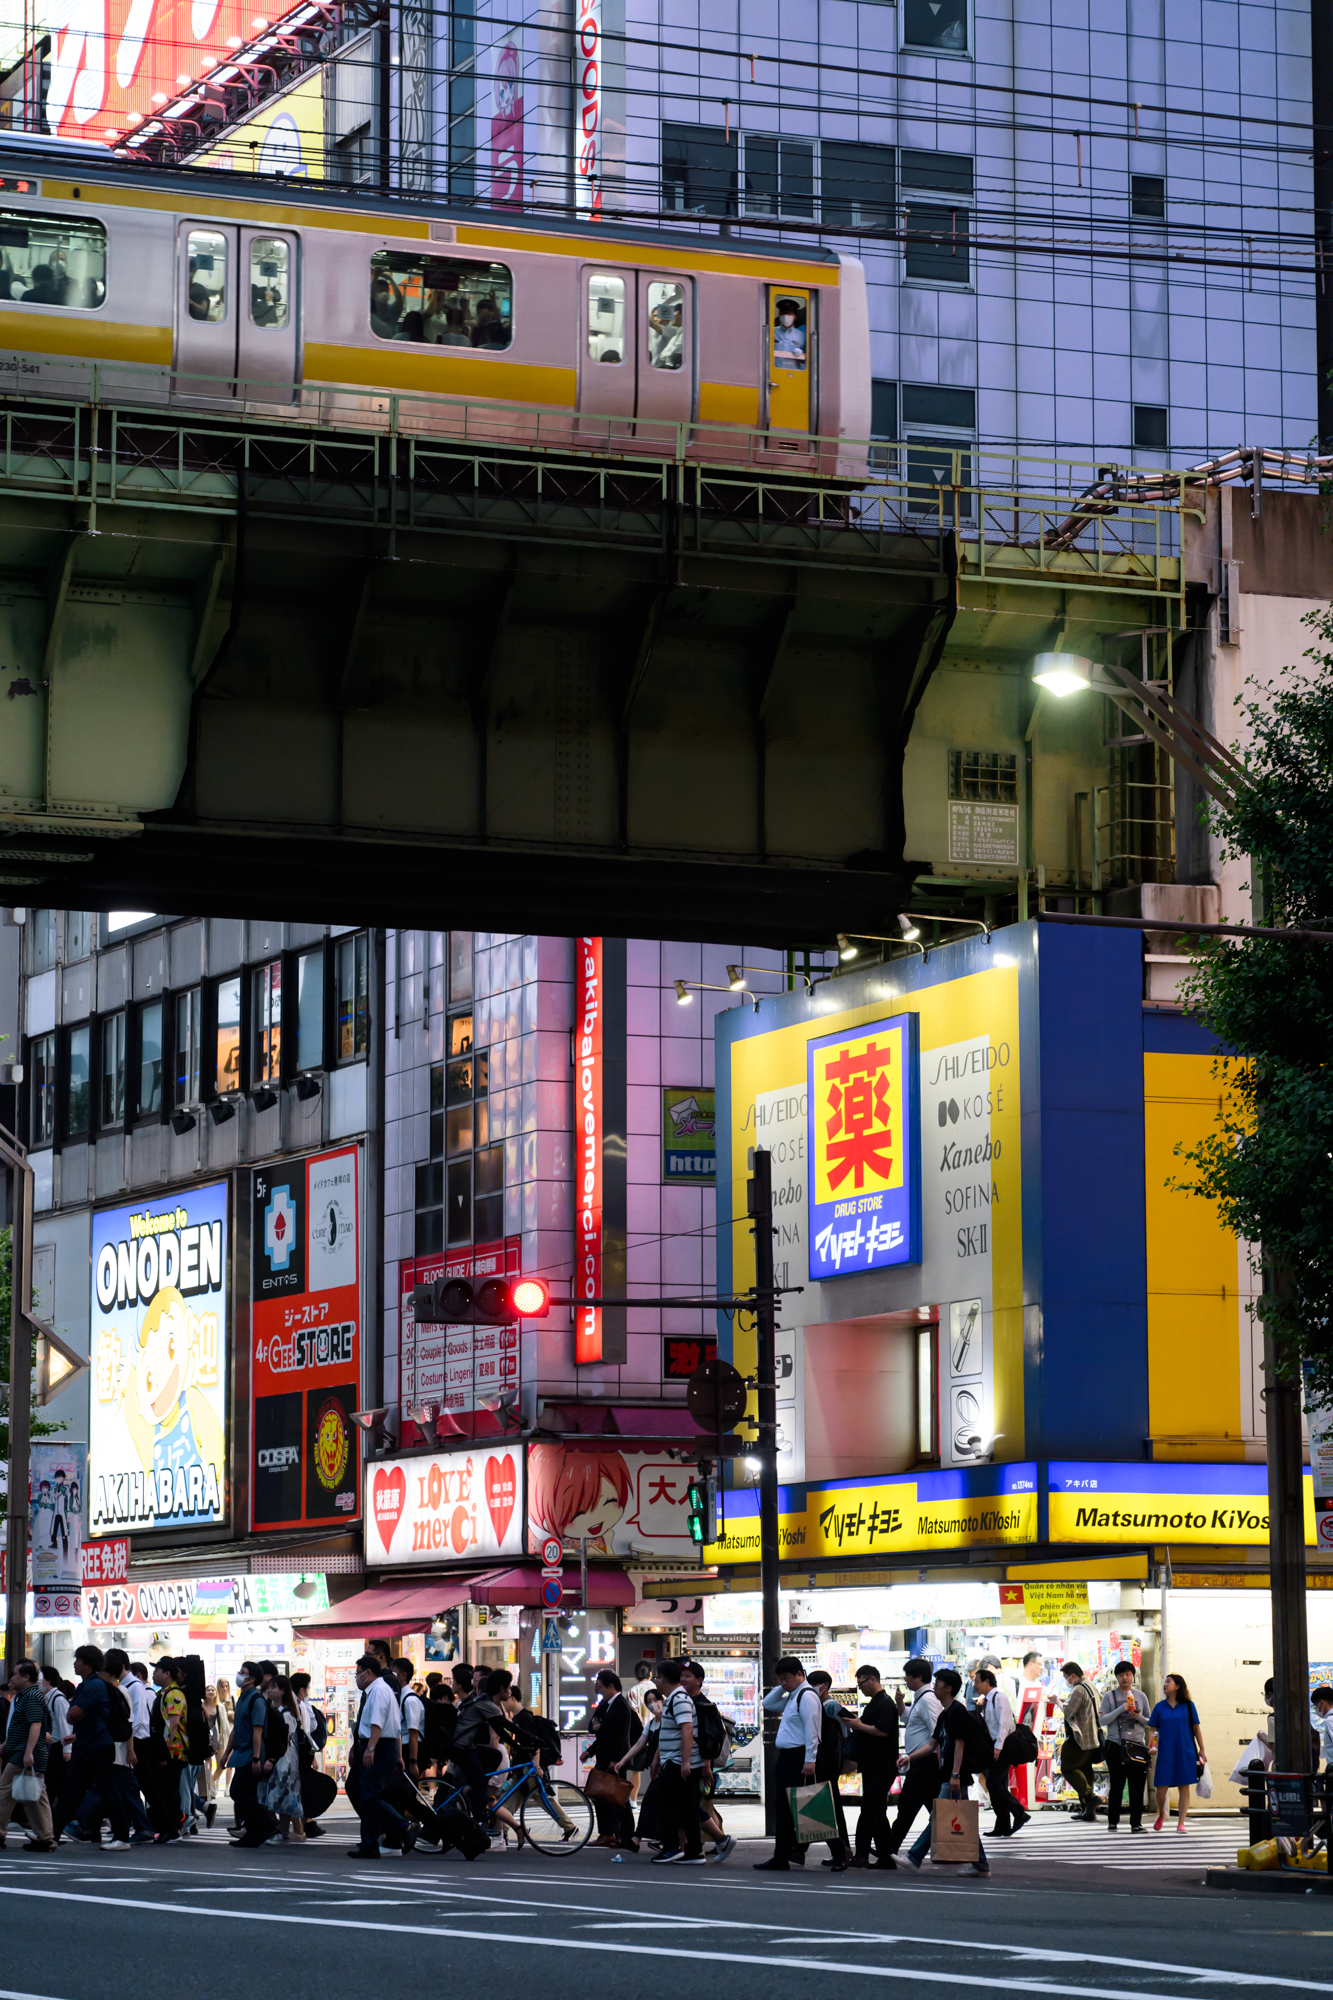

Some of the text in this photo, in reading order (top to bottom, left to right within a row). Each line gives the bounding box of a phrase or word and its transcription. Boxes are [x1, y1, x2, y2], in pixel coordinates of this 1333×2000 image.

[929, 1042, 1010, 1086] SHISEIDO
[740, 1094, 808, 1131] SHISEIDO
[963, 1083, 1004, 1121] KOSÉ
[674, 1117, 716, 1139] メー
[825, 1041, 893, 1192] 薬
[940, 1131, 1002, 1173] Kanebo
[256, 1178, 267, 1198] 5F
[770, 1176, 803, 1207] nebo
[945, 1181, 1000, 1215] SOFINA
[834, 1195, 883, 1218] DRUG STORE
[129, 1205, 188, 1239] Welcome to
[777, 1222, 800, 1247] INA
[815, 1215, 904, 1270] マツモトキヨシ
[96, 1219, 222, 1314] ONODEN
[446, 1263, 465, 1278] GUIDE
[772, 1261, 789, 1289] K-II
[285, 1302, 329, 1327] ジーストア
[191, 1311, 219, 1388] 迎
[255, 1339, 268, 1363] 4F
[447, 1340, 469, 1356] Goods
[420, 1370, 449, 1387] Costume
[258, 1446, 299, 1467] COSPA
[93, 1463, 220, 1525] AKIHABARA
[491, 1483, 501, 1494] OPEN
[1065, 1479, 1098, 1488] アキバ店
[376, 1488, 400, 1511] 秋葉原
[377, 1511, 398, 1521] AKIHABARA
[819, 1501, 903, 1547] マツモトキヨシ
[917, 1510, 1021, 1535] Matsumoto KiYoshi
[1075, 1508, 1270, 1530] Matsumoto KiYos
[717, 1526, 806, 1549] Matsumo iYoshi
[101, 1542, 127, 1580] 免税
[546, 1545, 559, 1560] 20
[89, 1588, 135, 1624] オノデン
[138, 1580, 193, 1620] ONODEN
[1029, 1592, 1045, 1600] Việt
[1040, 1602, 1079, 1611] phiên dịch.
[722, 1635, 751, 1644] waiting
[530, 1628, 542, 1708] 4F
